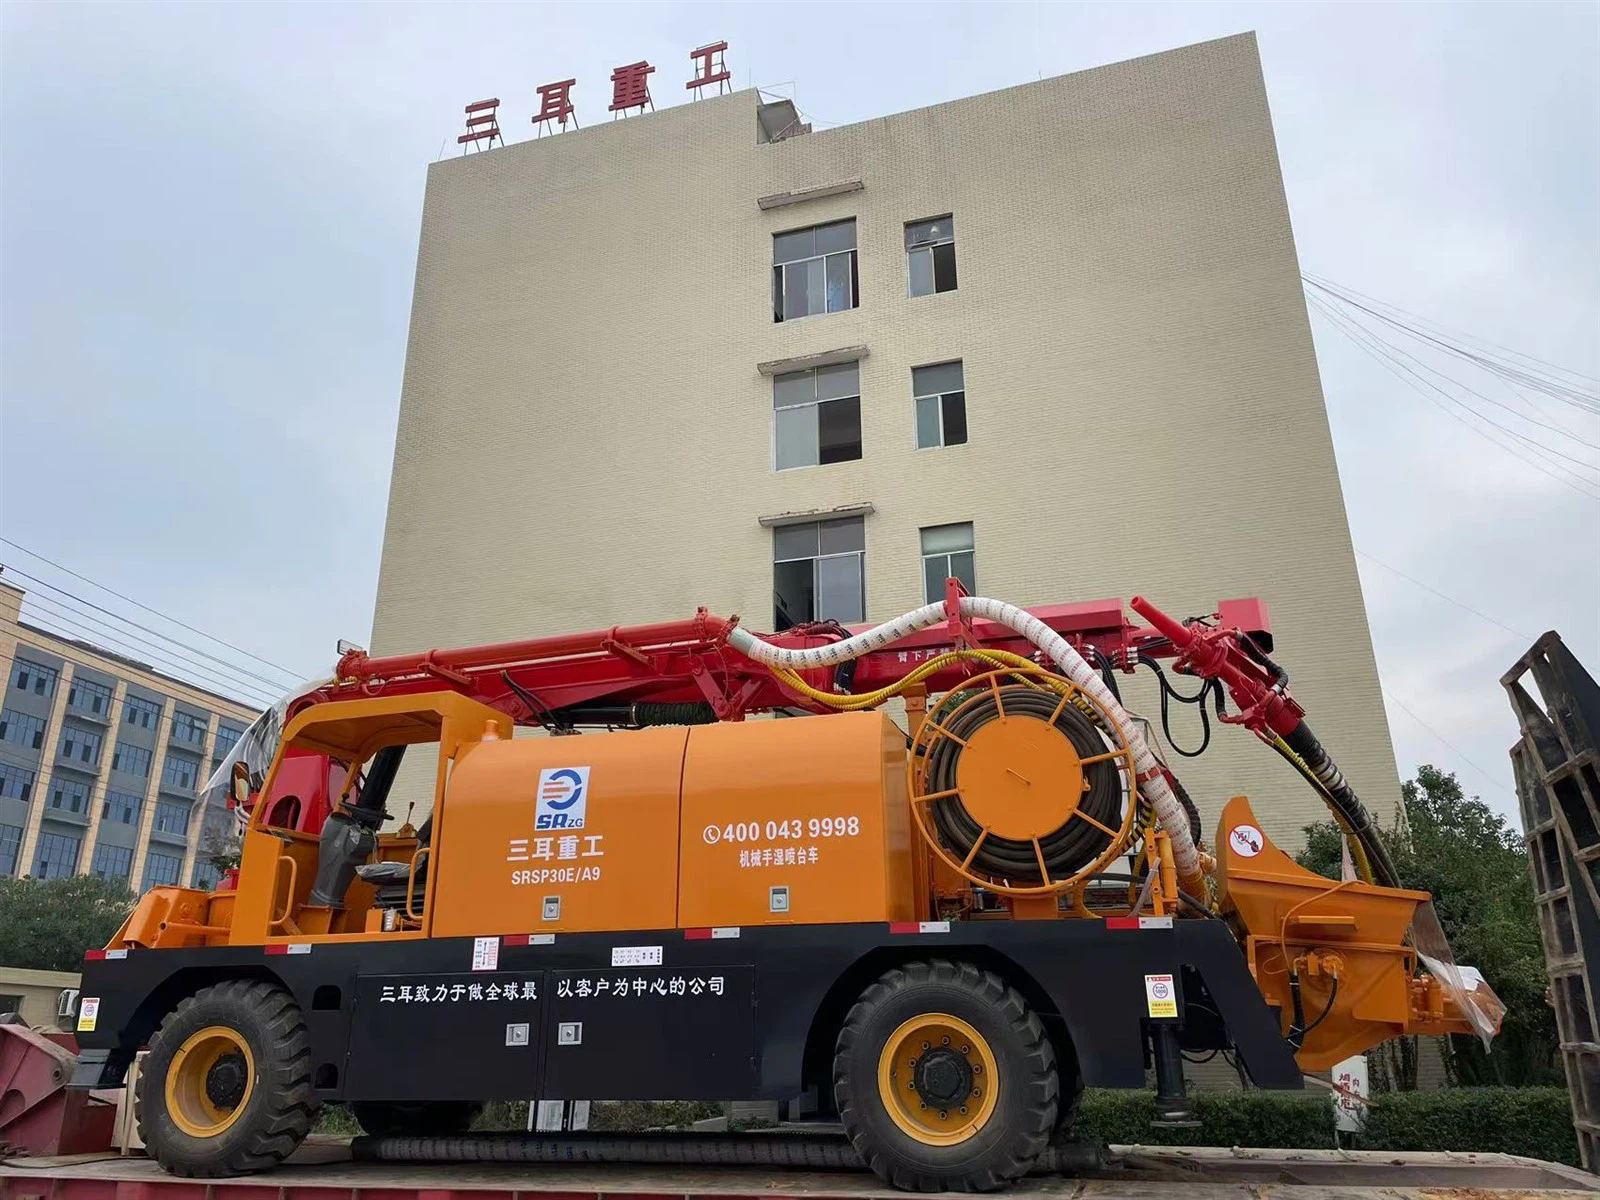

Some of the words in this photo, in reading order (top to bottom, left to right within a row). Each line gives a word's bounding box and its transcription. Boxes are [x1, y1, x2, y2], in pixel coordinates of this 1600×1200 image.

[457, 41, 731, 144] 三耳重工
[723, 822, 760, 843] 400
[765, 819, 803, 841] 043
[808, 816, 860, 838] 9998
[506, 835, 604, 861] 三耳重工
[739, 846, 819, 868] 机械手湿喷台车
[511, 866, 601, 885] SRSP30E/A9
[379, 981, 538, 1003] 三耳致力于做全球最
[556, 975, 724, 998] 以客户为中心的公司
